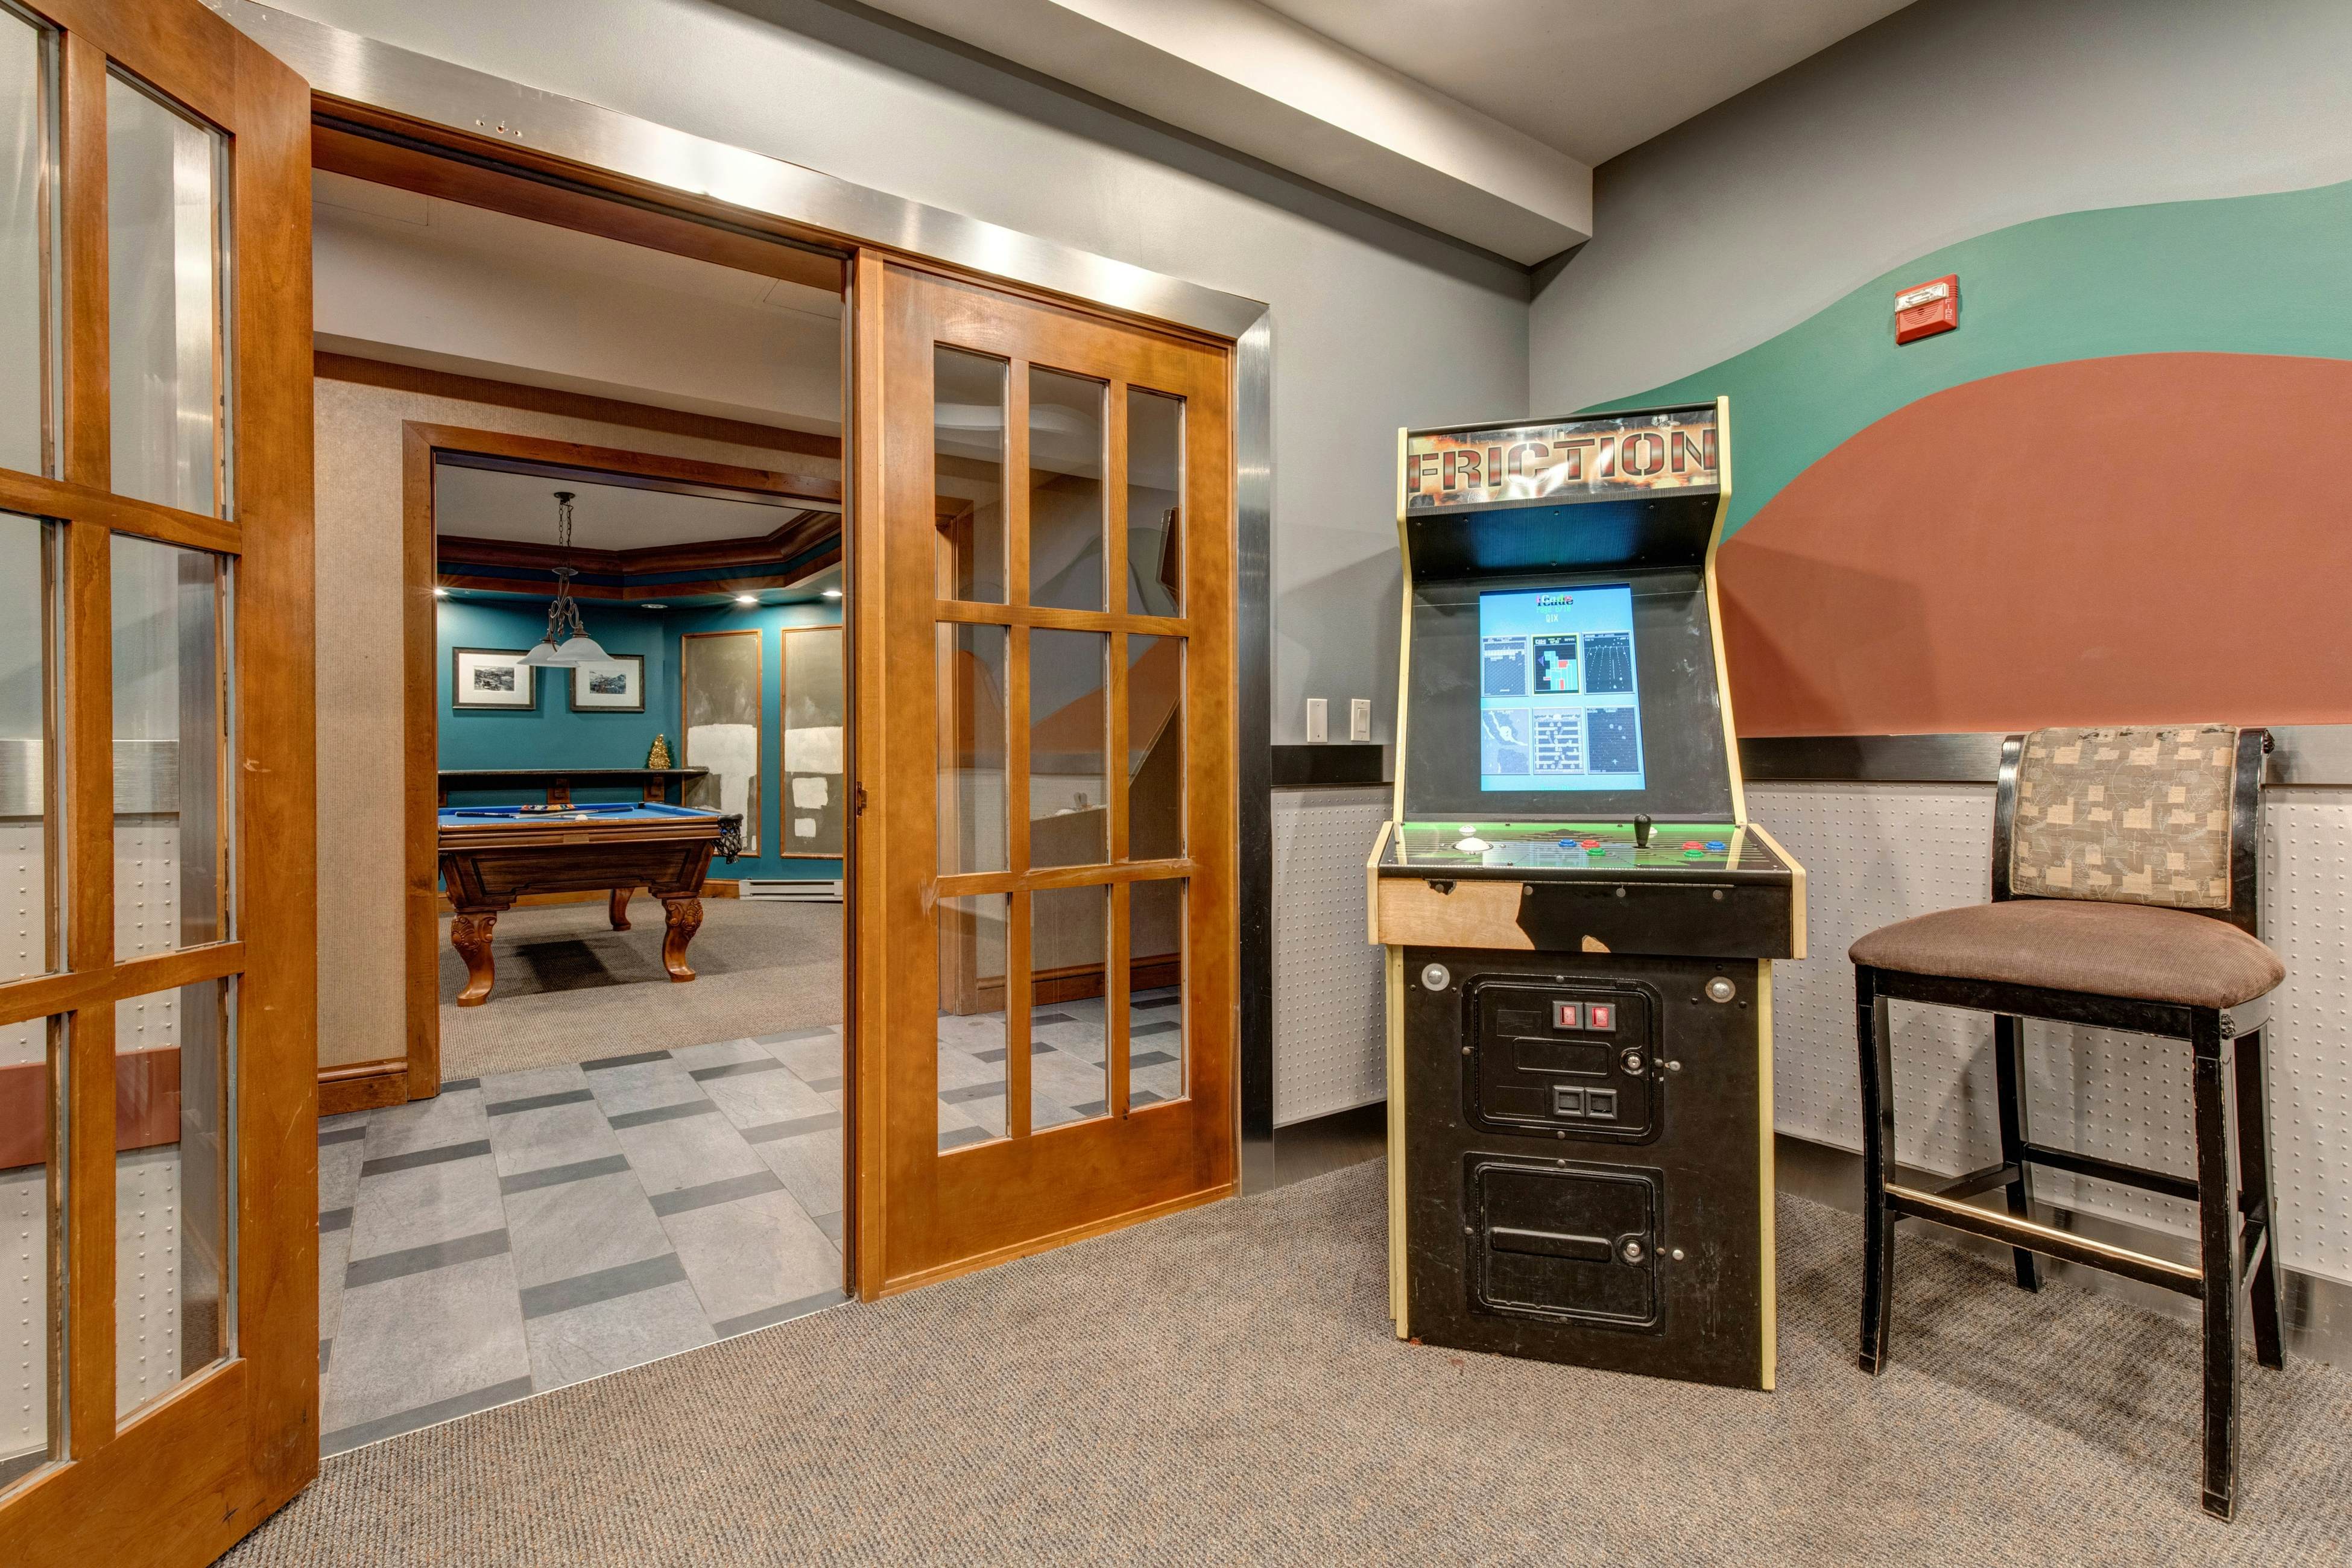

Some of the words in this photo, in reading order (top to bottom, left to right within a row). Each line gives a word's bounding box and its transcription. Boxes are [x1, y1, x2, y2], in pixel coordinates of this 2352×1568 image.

[1945, 299, 1953, 320] FIRE
[1408, 429, 1718, 493] FRICTION
[1546, 614, 1559, 623] QIX
